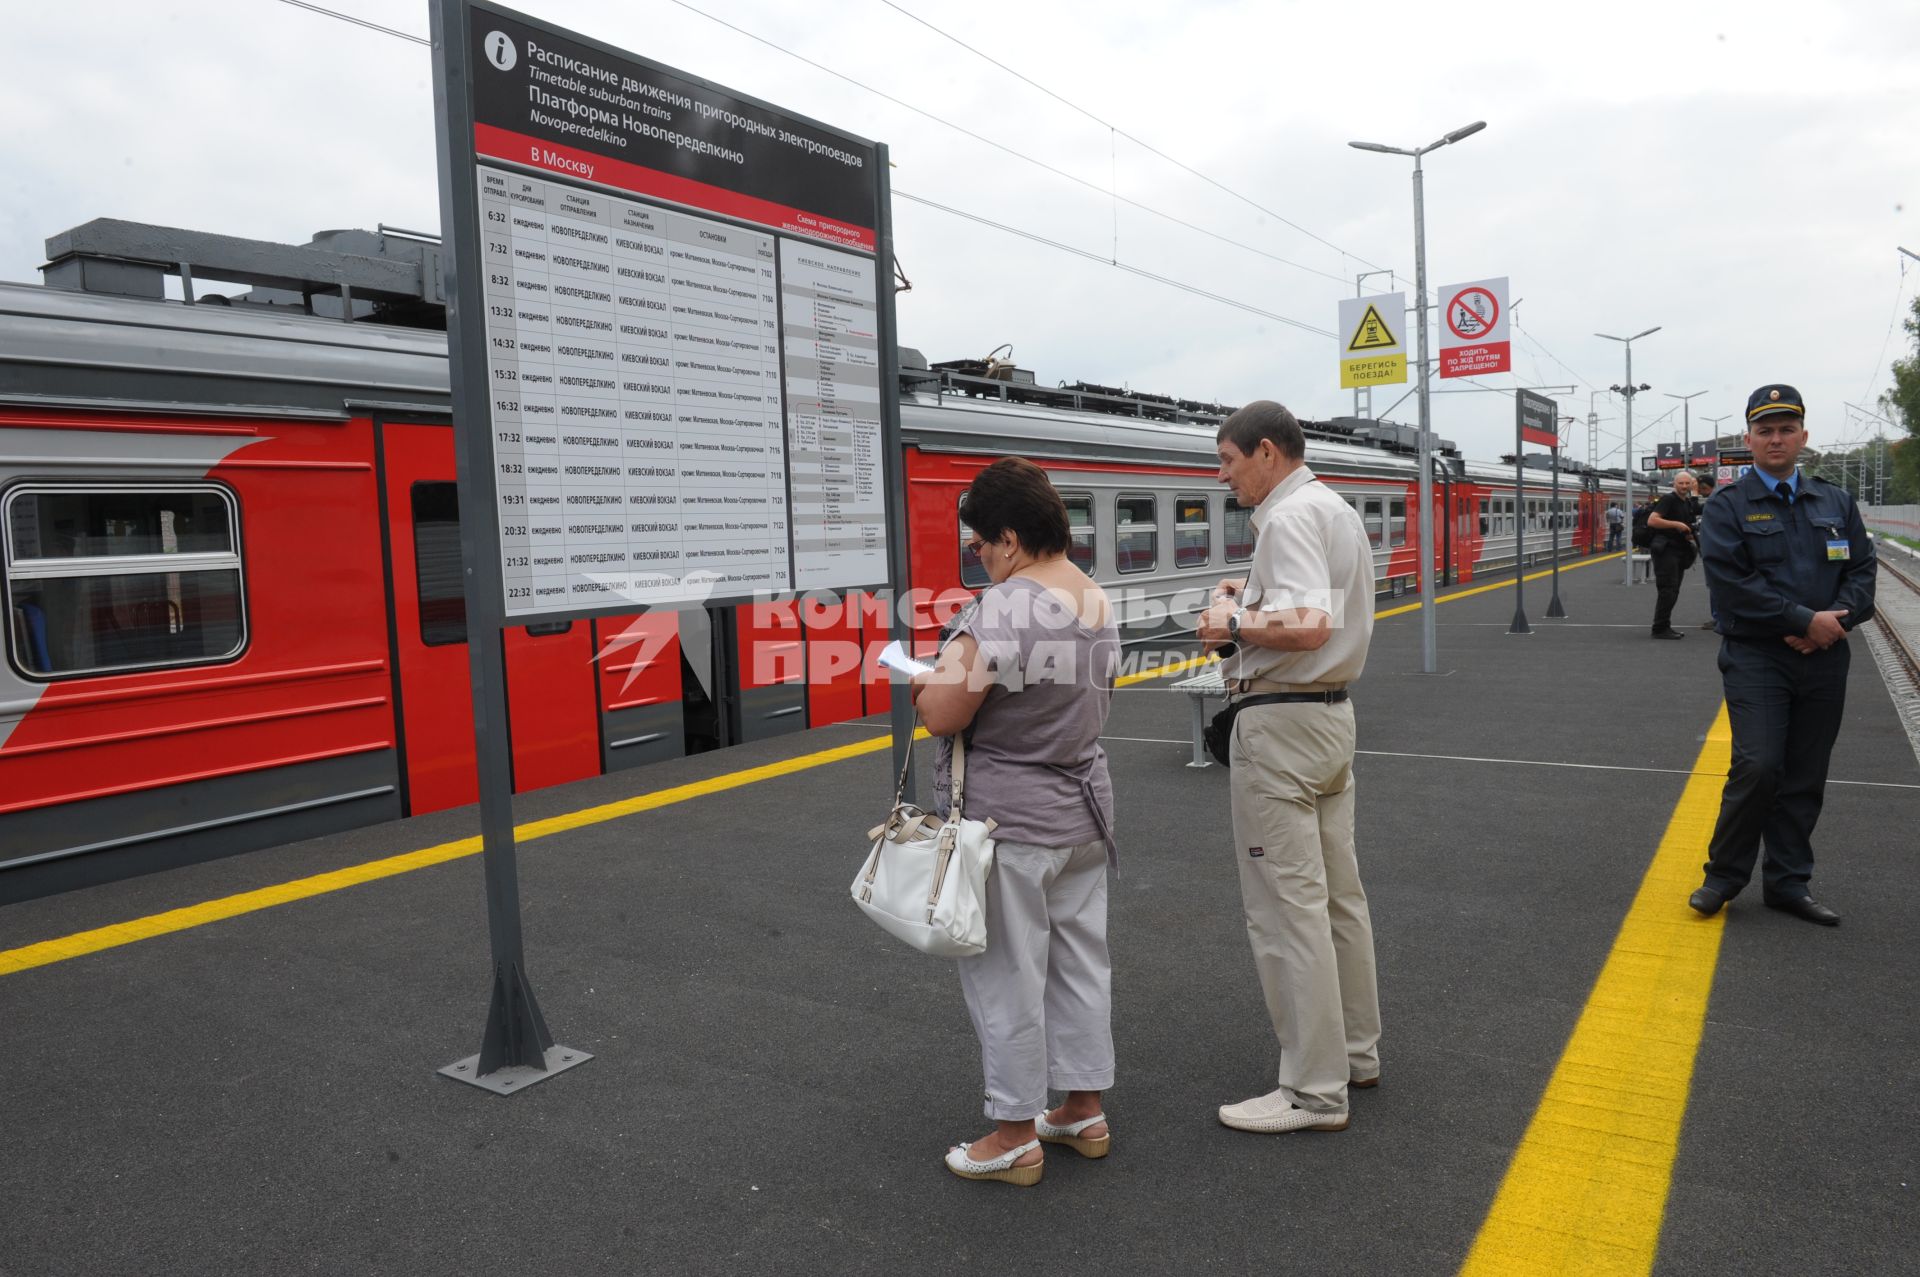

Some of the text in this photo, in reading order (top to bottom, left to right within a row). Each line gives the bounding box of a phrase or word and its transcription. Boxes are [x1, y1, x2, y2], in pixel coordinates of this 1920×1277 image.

[529, 65, 672, 121] Timetable suburban trains
[527, 41, 863, 167] Расписание движения пригородных электропоездов
[529, 85, 744, 164] Платформа Новопеределкино
[530, 109, 627, 147] Novoperedelkino
[531, 147, 594, 178] В Москву
[486, 175, 504, 186] ВРЕМЯ
[522, 184, 532, 192] ДНИ
[510, 193, 544, 206] КУРСИРОВАНИЯ
[566, 194, 590, 206] СТАНЦИЯ
[560, 204, 597, 218] ОТПРАВЛЕНИЯ
[627, 209, 648, 219] СТАНЦИЯ
[487, 210, 505, 223] 6:32
[513, 218, 544, 232] ежедневно
[551, 224, 608, 244] НОВОПЕРЕДЕЛКИНО
[615, 236, 643, 251] КИЕВСКИЙ
[643, 243, 663, 255] ВОКЗАЛ
[797, 214, 861, 239] Схема пригородного
[699, 230, 726, 243] ОСТАНОВКИ
[782, 222, 875, 251] железнодорожного сообщения
[489, 242, 507, 254] 7:32
[515, 249, 546, 263] ежедневно
[552, 255, 609, 274] НОВОПЕРЕДЕЛКИНО
[617, 265, 644, 279] КИЕВСКИЙ
[645, 272, 665, 283] ВОКЗАЛ
[491, 274, 509, 286] 8:32
[517, 280, 548, 293] ежедневно
[554, 285, 611, 303] НОВОПЕРЕДЕЛКИНО
[618, 294, 646, 308] КИЕВСКИЙ
[646, 300, 666, 311] ВОКЗАЛ
[491, 306, 512, 317] 13:32
[518, 311, 549, 324] ежедневно
[556, 316, 612, 332] НОВОПЕРЕДЕЛКИНО
[620, 323, 647, 336] КИЕВСКИЙ
[648, 328, 667, 339] ВОКЗАЛ
[493, 338, 514, 349] 14:32
[520, 342, 551, 354] ежедневно
[558, 346, 614, 361] НОВОПЕРЕДЕЛКИНО
[622, 352, 649, 364] КИЕВСКИЙ
[649, 356, 669, 366] ВОКЗАЛ
[1447, 358, 1458, 366] ПО
[1476, 353, 1501, 363] ПУТЯМ
[1459, 348, 1488, 357] ХОДИТЬ
[1349, 360, 1397, 372] БЕРЕГИСЬ
[1450, 361, 1498, 373] ЗАПРЕЩЕНО!
[495, 369, 516, 380] 15:32
[522, 373, 553, 384] ежедневно
[560, 376, 616, 390] НОВОПЕРЕДЕЛКИНО
[623, 381, 650, 392] КИЕВСКИЙ
[651, 384, 670, 394] ВОКЗАЛ
[1353, 370, 1393, 381] ПОЕЗДА!
[497, 401, 518, 411] 16:32
[524, 404, 555, 415] ежедневно
[561, 406, 617, 418] НОВОПЕРЕДЕЛКИНО
[625, 409, 652, 420] КИЕВСКИЙ
[652, 412, 672, 421] ВОКЗАЛ
[499, 433, 520, 442] 17:32
[526, 435, 556, 445] ежедневно
[563, 436, 619, 447] НОВОПЕРЕДЕЛКИНО
[626, 438, 653, 448] КИЕВСКИЙ
[654, 440, 673, 449] ВОКЗАЛ
[1665, 446, 1673, 457] 2
[1700, 444, 1706, 455] 1
[501, 464, 522, 473] 18:32
[528, 466, 558, 475] ежедневно
[565, 466, 620, 476] НОВОПЕРЕДЕЛКИНО
[628, 466, 654, 476] КИЕВСКИЙ
[655, 468, 675, 476] ВОКЗАЛ
[503, 495, 524, 504] 19:31
[530, 496, 560, 505] ежедневно
[567, 496, 622, 505] НОВОПЕРЕДЕЛКИНО
[629, 495, 656, 503] КИЕВСКИЙ
[504, 526, 526, 535] 20:32
[531, 526, 561, 535] ежедневно
[568, 524, 623, 534] НОВОПЕРЕДЕЛКИНО
[631, 522, 657, 532] КИЕВСКИЙ
[658, 523, 677, 531] ВОКЗАЛ
[506, 557, 528, 566] 21:32
[533, 556, 563, 566] ежедневно
[570, 553, 625, 564] НОВОПЕРЕДЕЛКИНО
[633, 550, 659, 560] КИЕВСКИЙ
[660, 550, 679, 558] ВОКЗАЛ
[508, 587, 530, 597] 22:32
[535, 585, 565, 596] ежедневно
[572, 581, 626, 593] НОВОПЕРЕДЕЛКИНО
